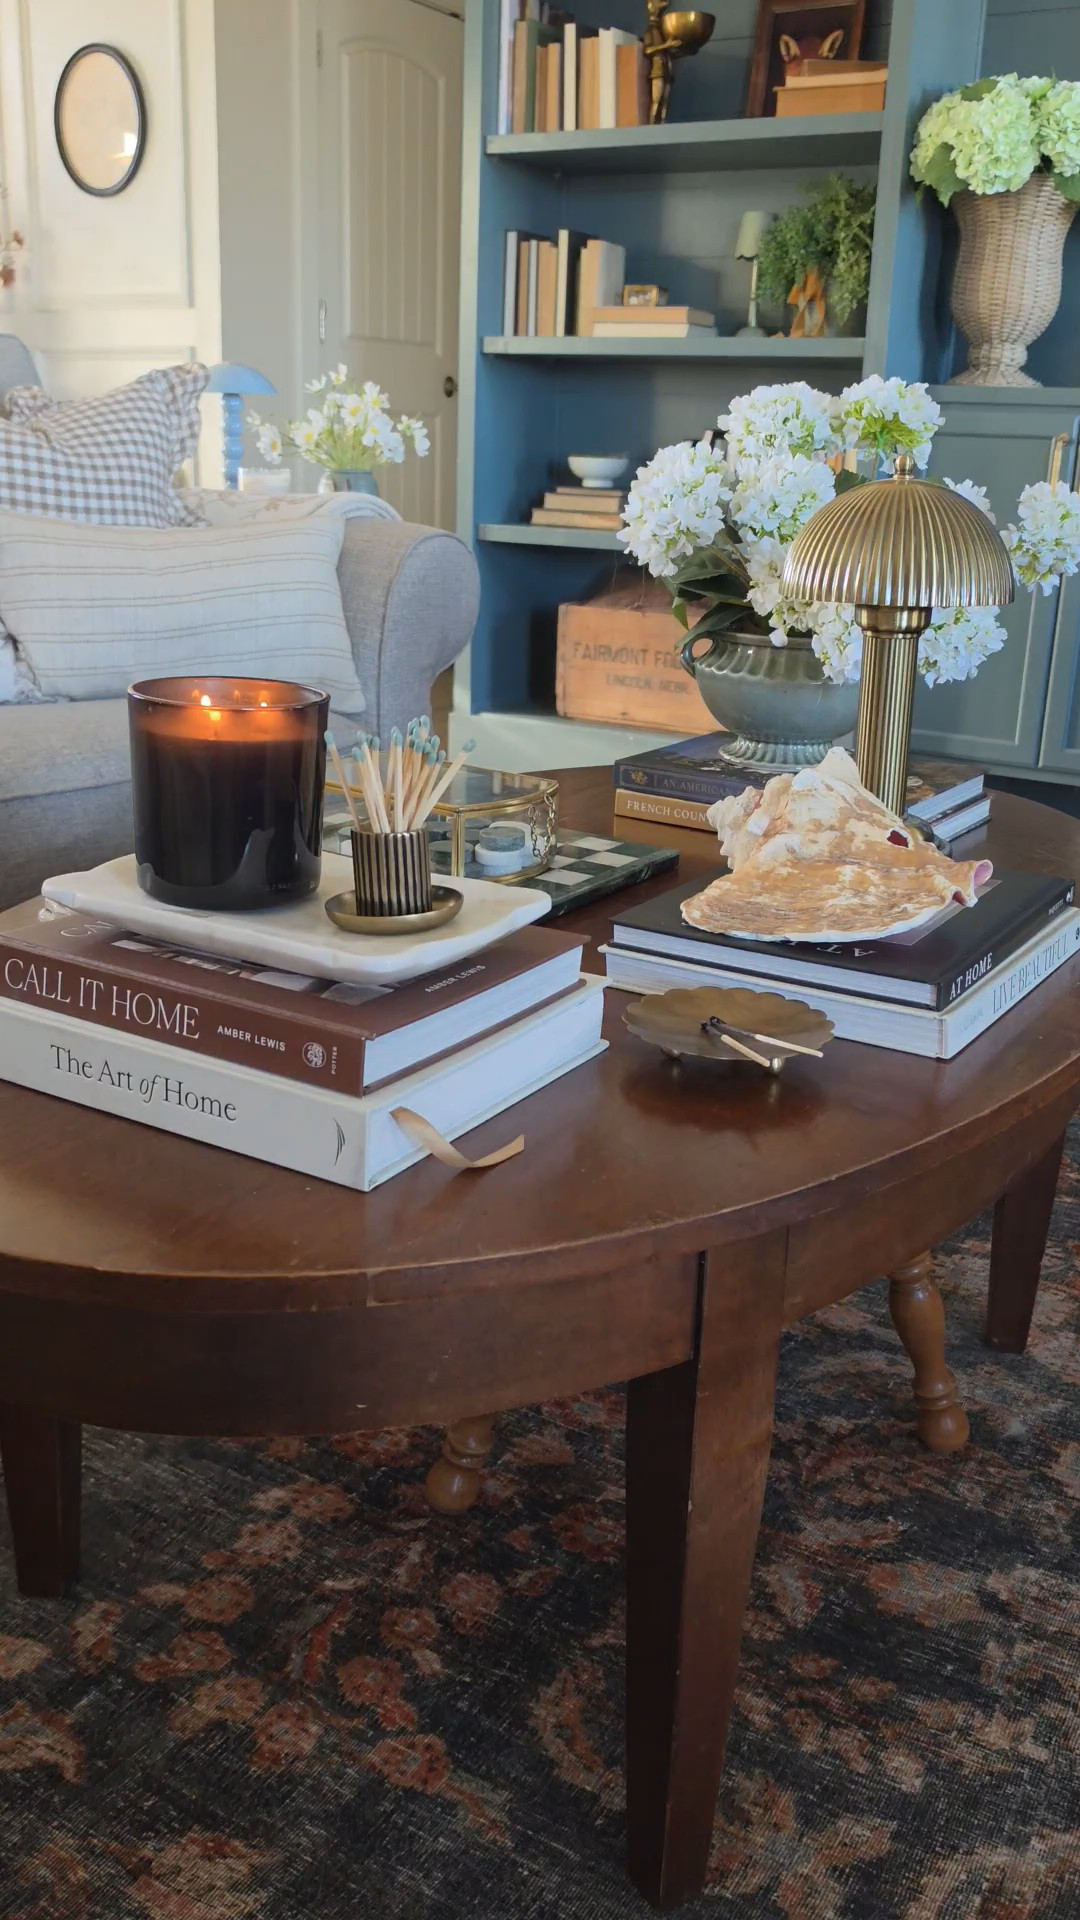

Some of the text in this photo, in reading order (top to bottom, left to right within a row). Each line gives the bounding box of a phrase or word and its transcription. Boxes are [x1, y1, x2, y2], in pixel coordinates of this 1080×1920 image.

[654, 650, 683, 670] FOO
[626, 800, 708, 822] FRENCH COUN
[4, 957, 200, 1040] CALL IT HOME
[949, 952, 993, 1001] AT HOME
[992, 933, 1069, 1016] LIVE BEAUTIFUL
[217, 1025, 286, 1052] AMBER LEWIS
[50, 1044, 237, 1122] The Art of Home
